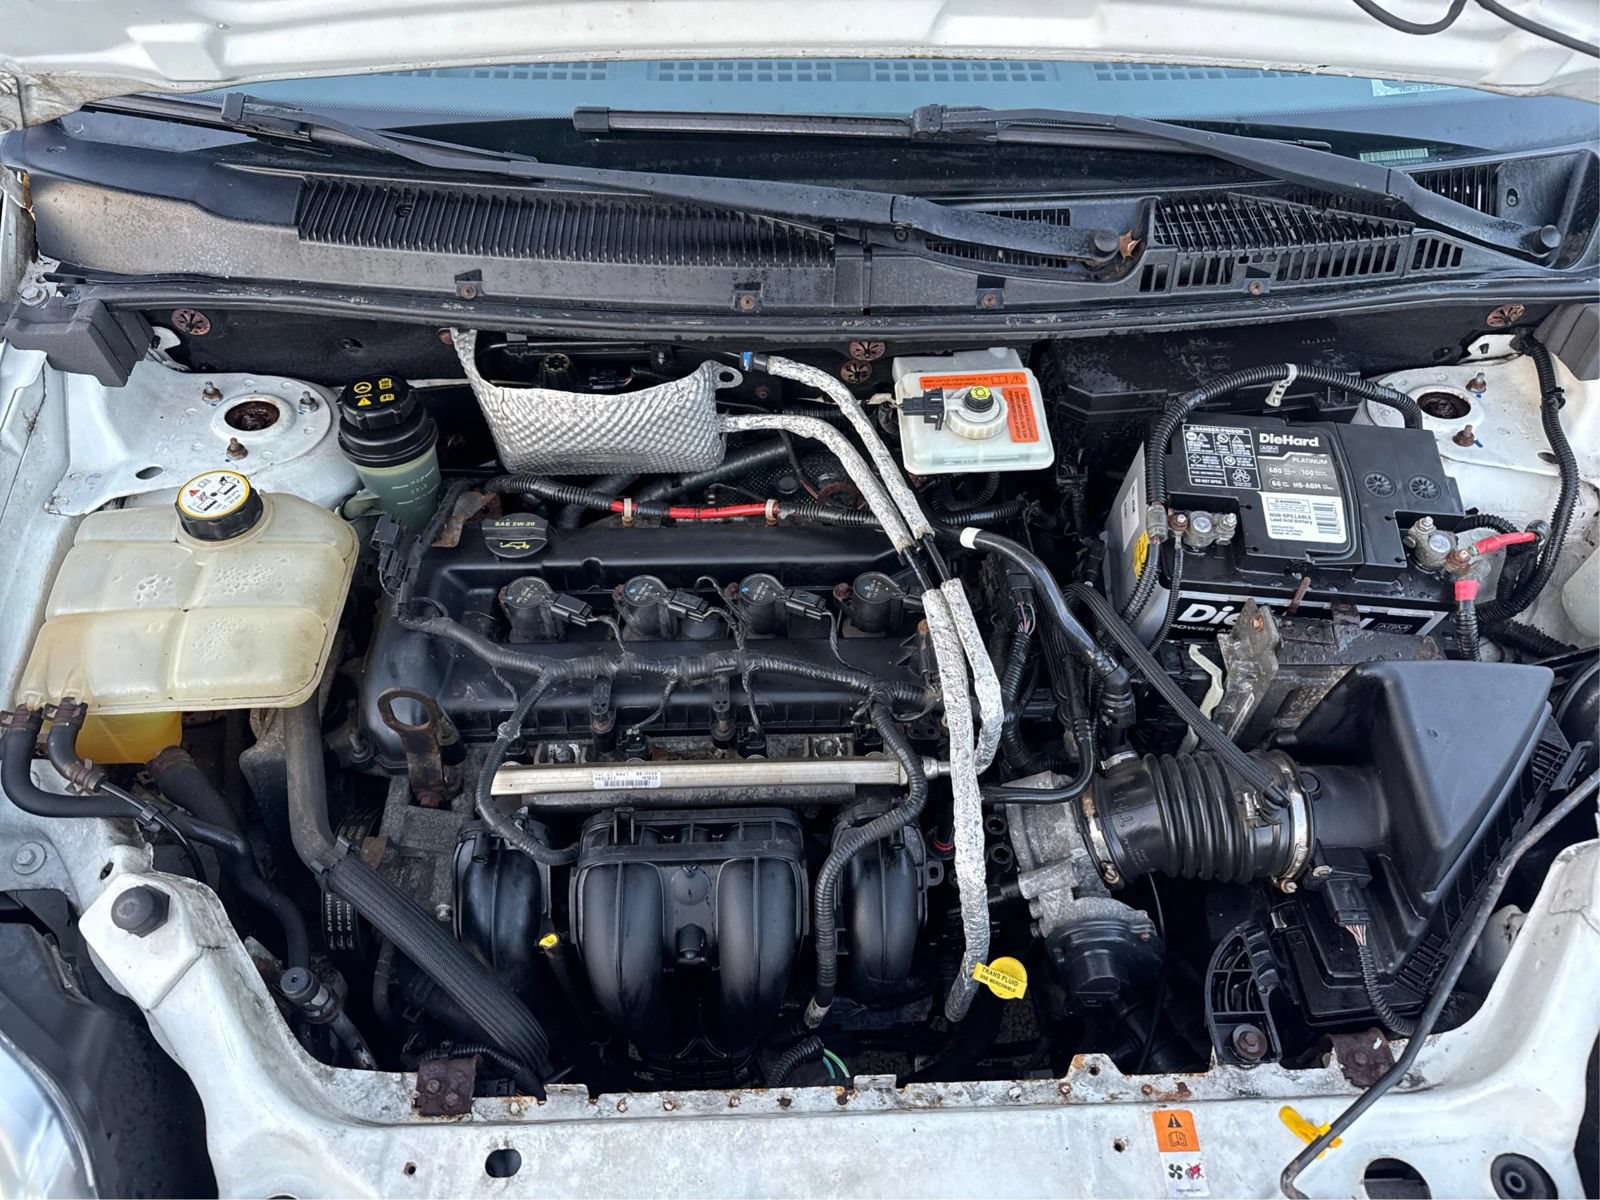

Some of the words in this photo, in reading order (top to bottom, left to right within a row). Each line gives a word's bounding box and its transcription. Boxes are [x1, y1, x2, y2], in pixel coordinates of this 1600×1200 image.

[1259, 432, 1320, 447] DieHard
[1292, 457, 1328, 465] PLATINUM
[981, 966, 1001, 980] TRANS
[1001, 975, 1019, 986] FLUID
